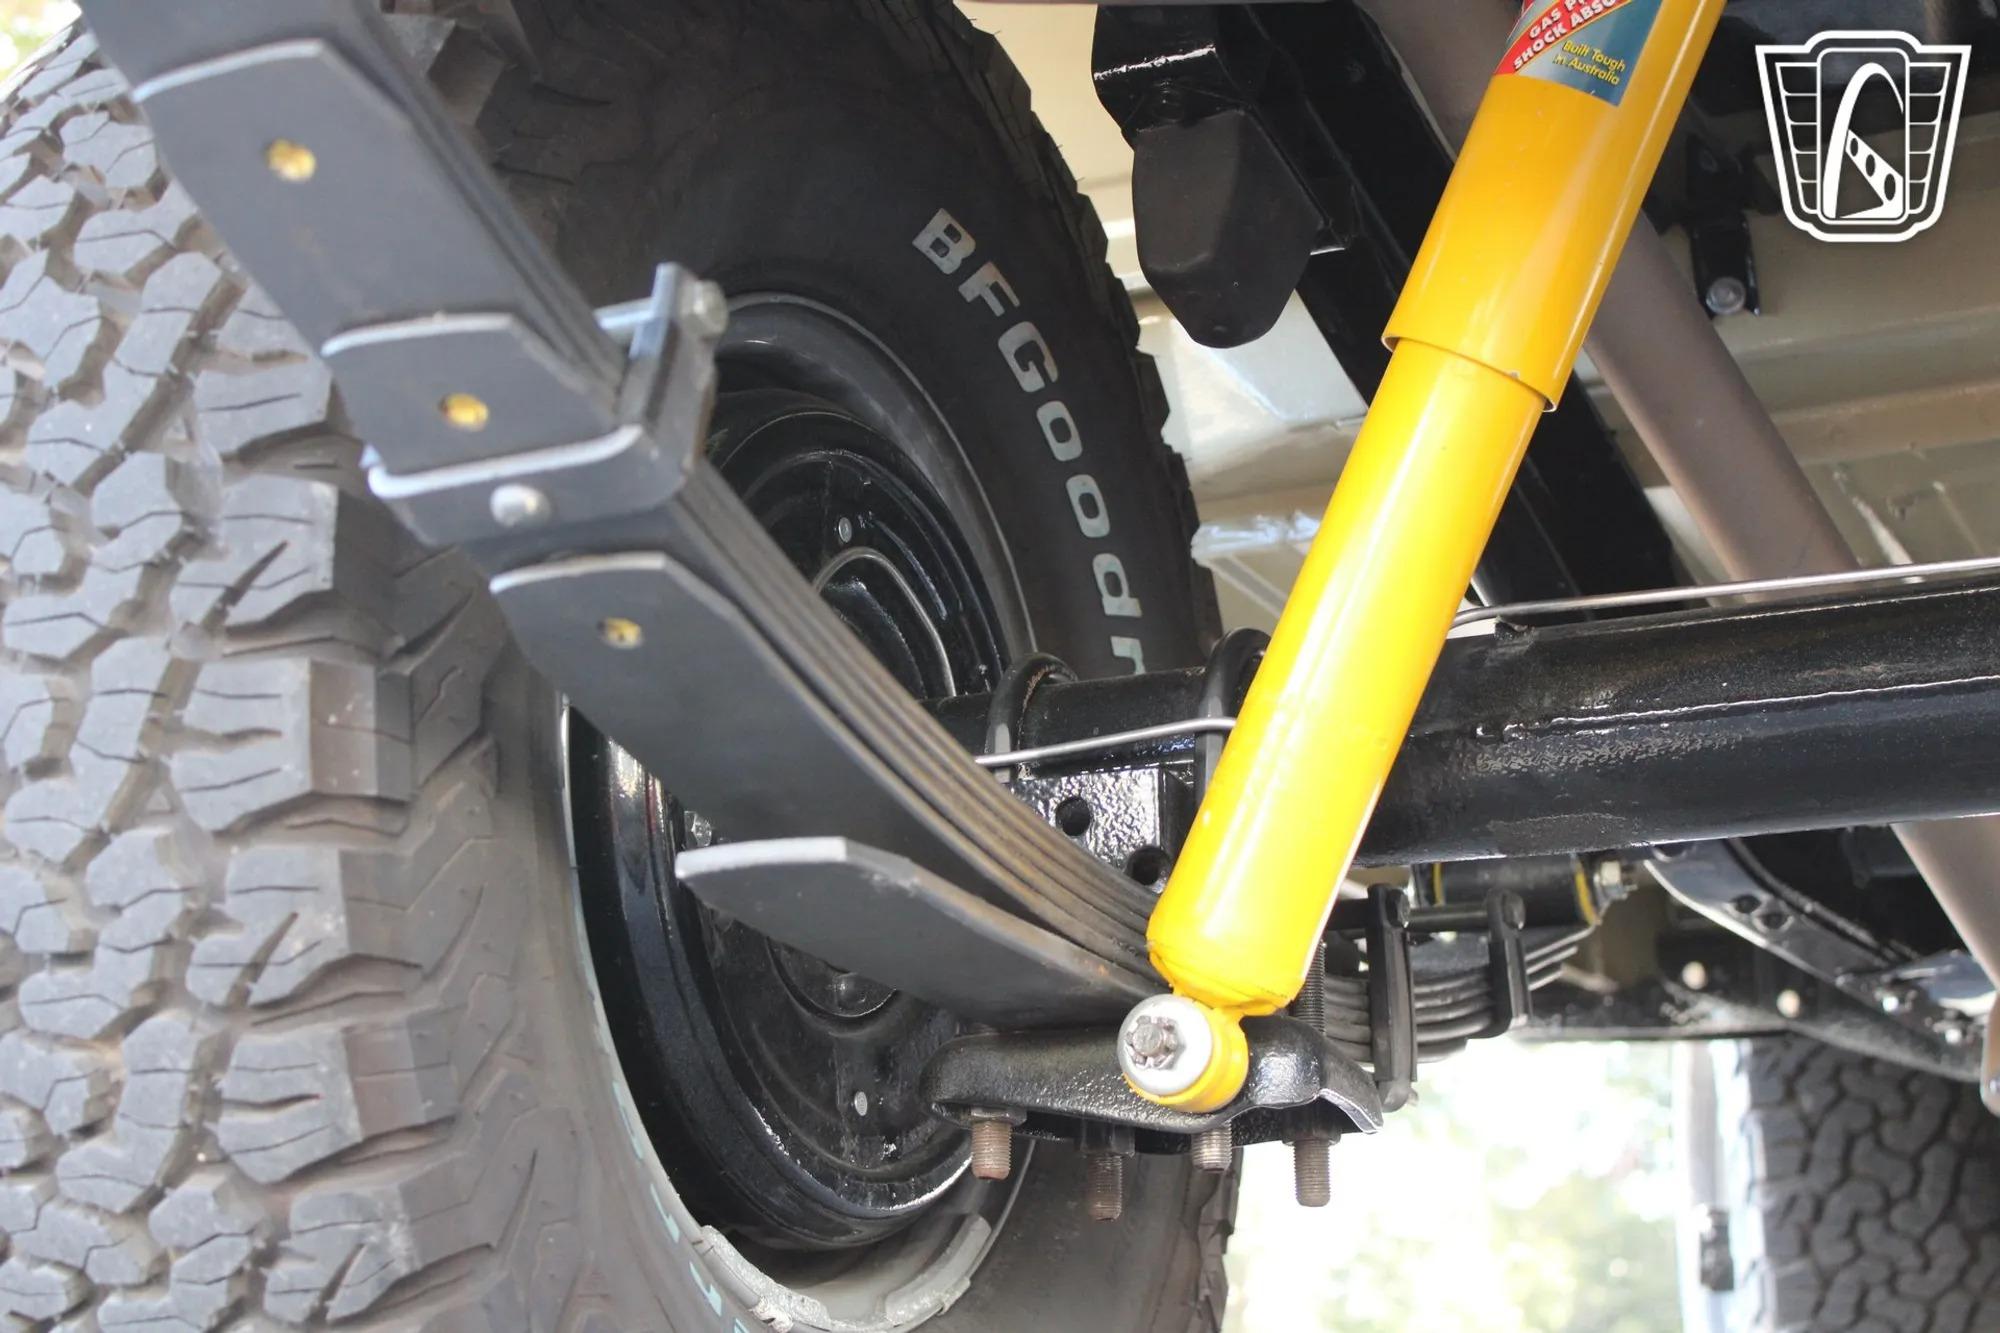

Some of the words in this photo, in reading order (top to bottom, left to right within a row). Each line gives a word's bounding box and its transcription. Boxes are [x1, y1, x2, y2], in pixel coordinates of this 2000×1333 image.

[1529, 8, 1561, 38] GAS
[1514, 22, 1567, 69] SHOCK
[1563, 40, 1590, 57] Built
[1592, 48, 1626, 72] Tough
[1567, 57, 1620, 86] Australia
